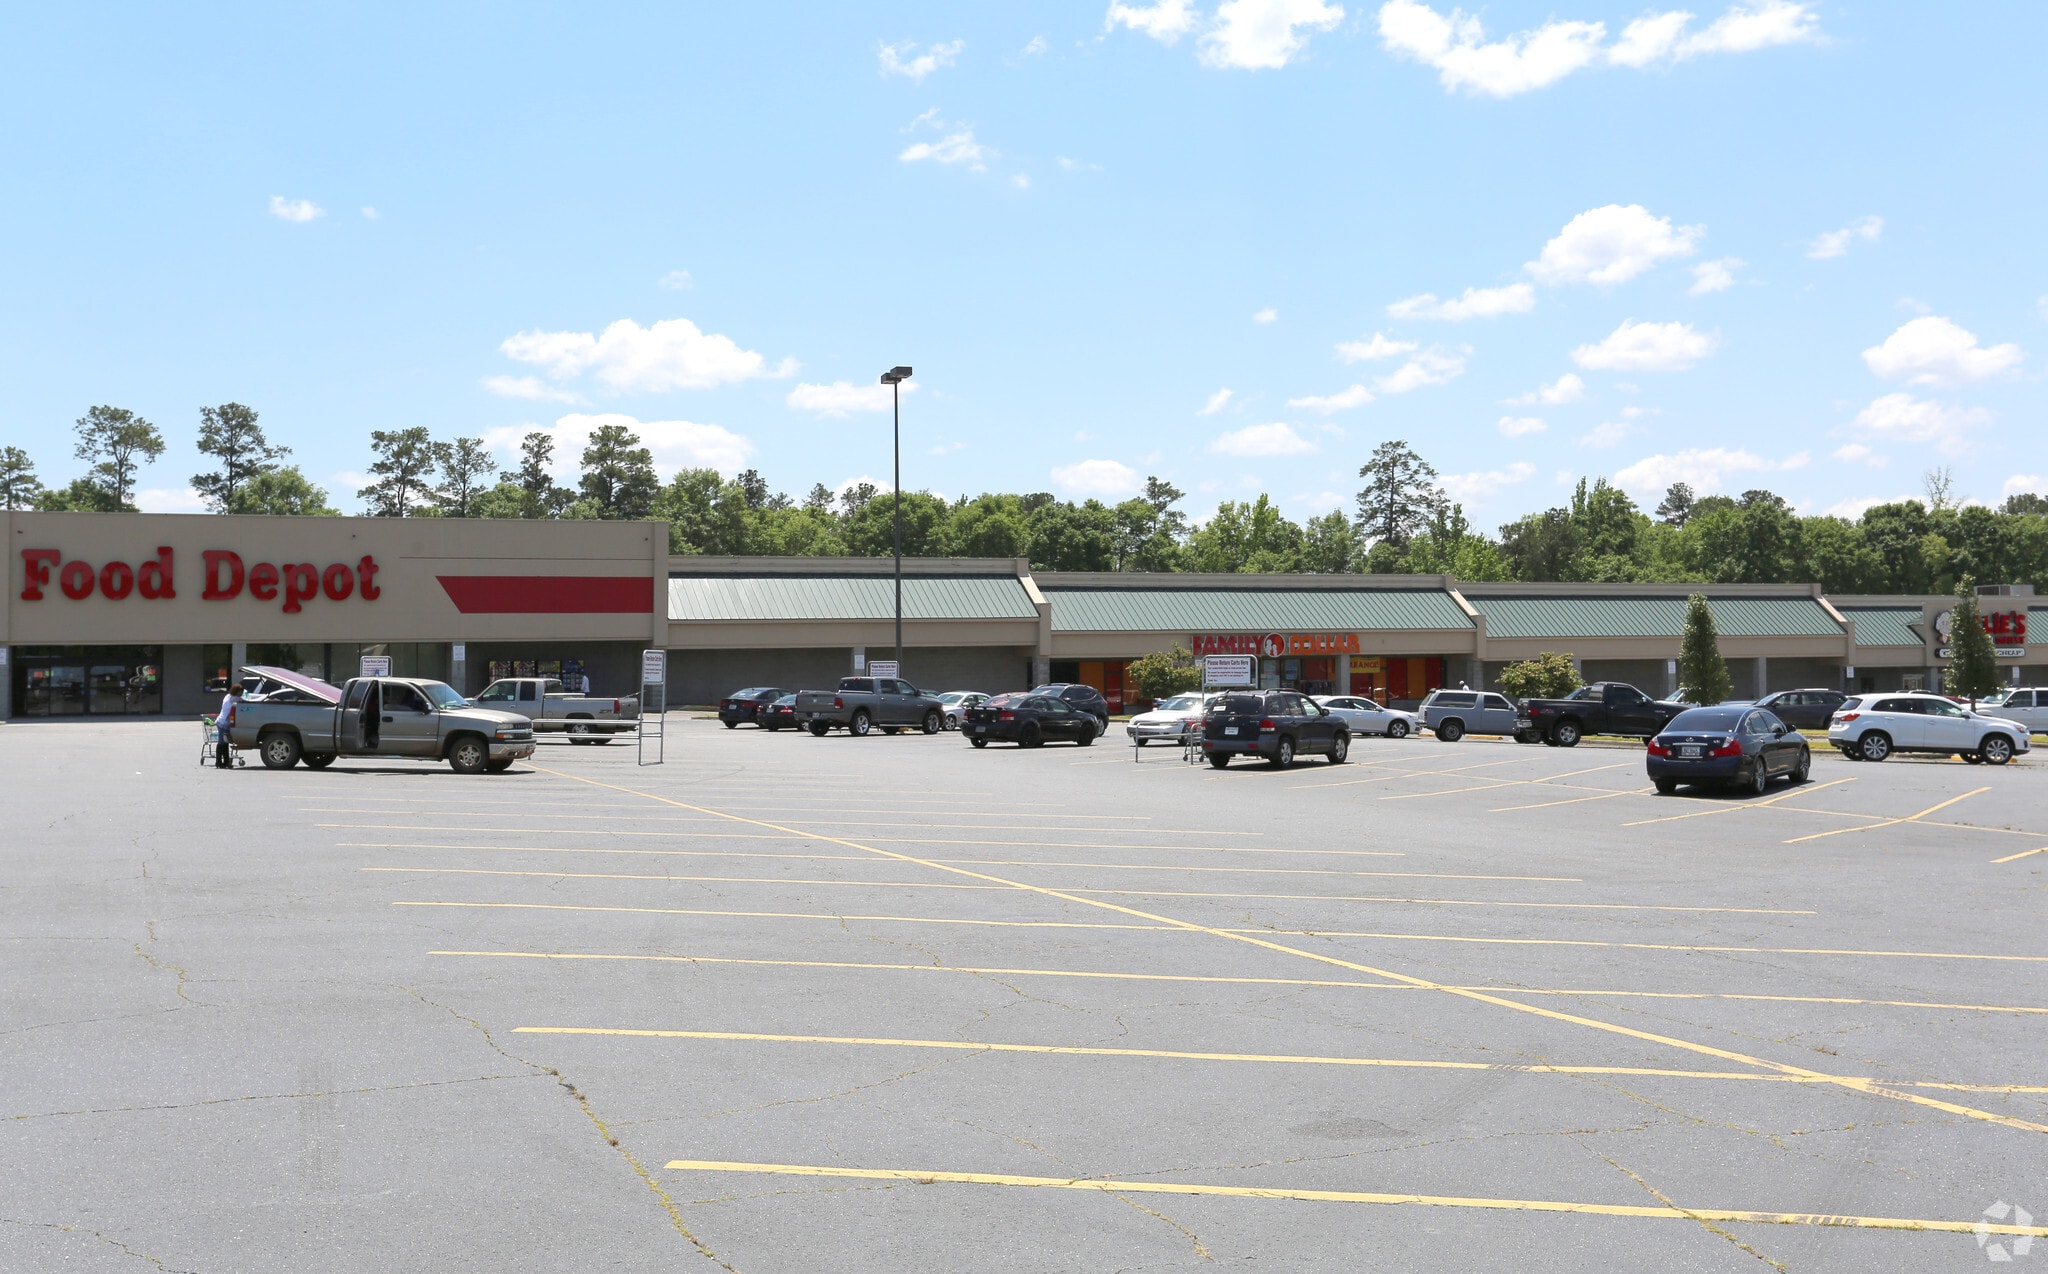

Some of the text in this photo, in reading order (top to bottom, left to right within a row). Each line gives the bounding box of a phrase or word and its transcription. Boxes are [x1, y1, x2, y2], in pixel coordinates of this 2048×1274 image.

[20, 546, 381, 614] Food Depot
[1193, 634, 1360, 654] FAMILY DOLLAR
